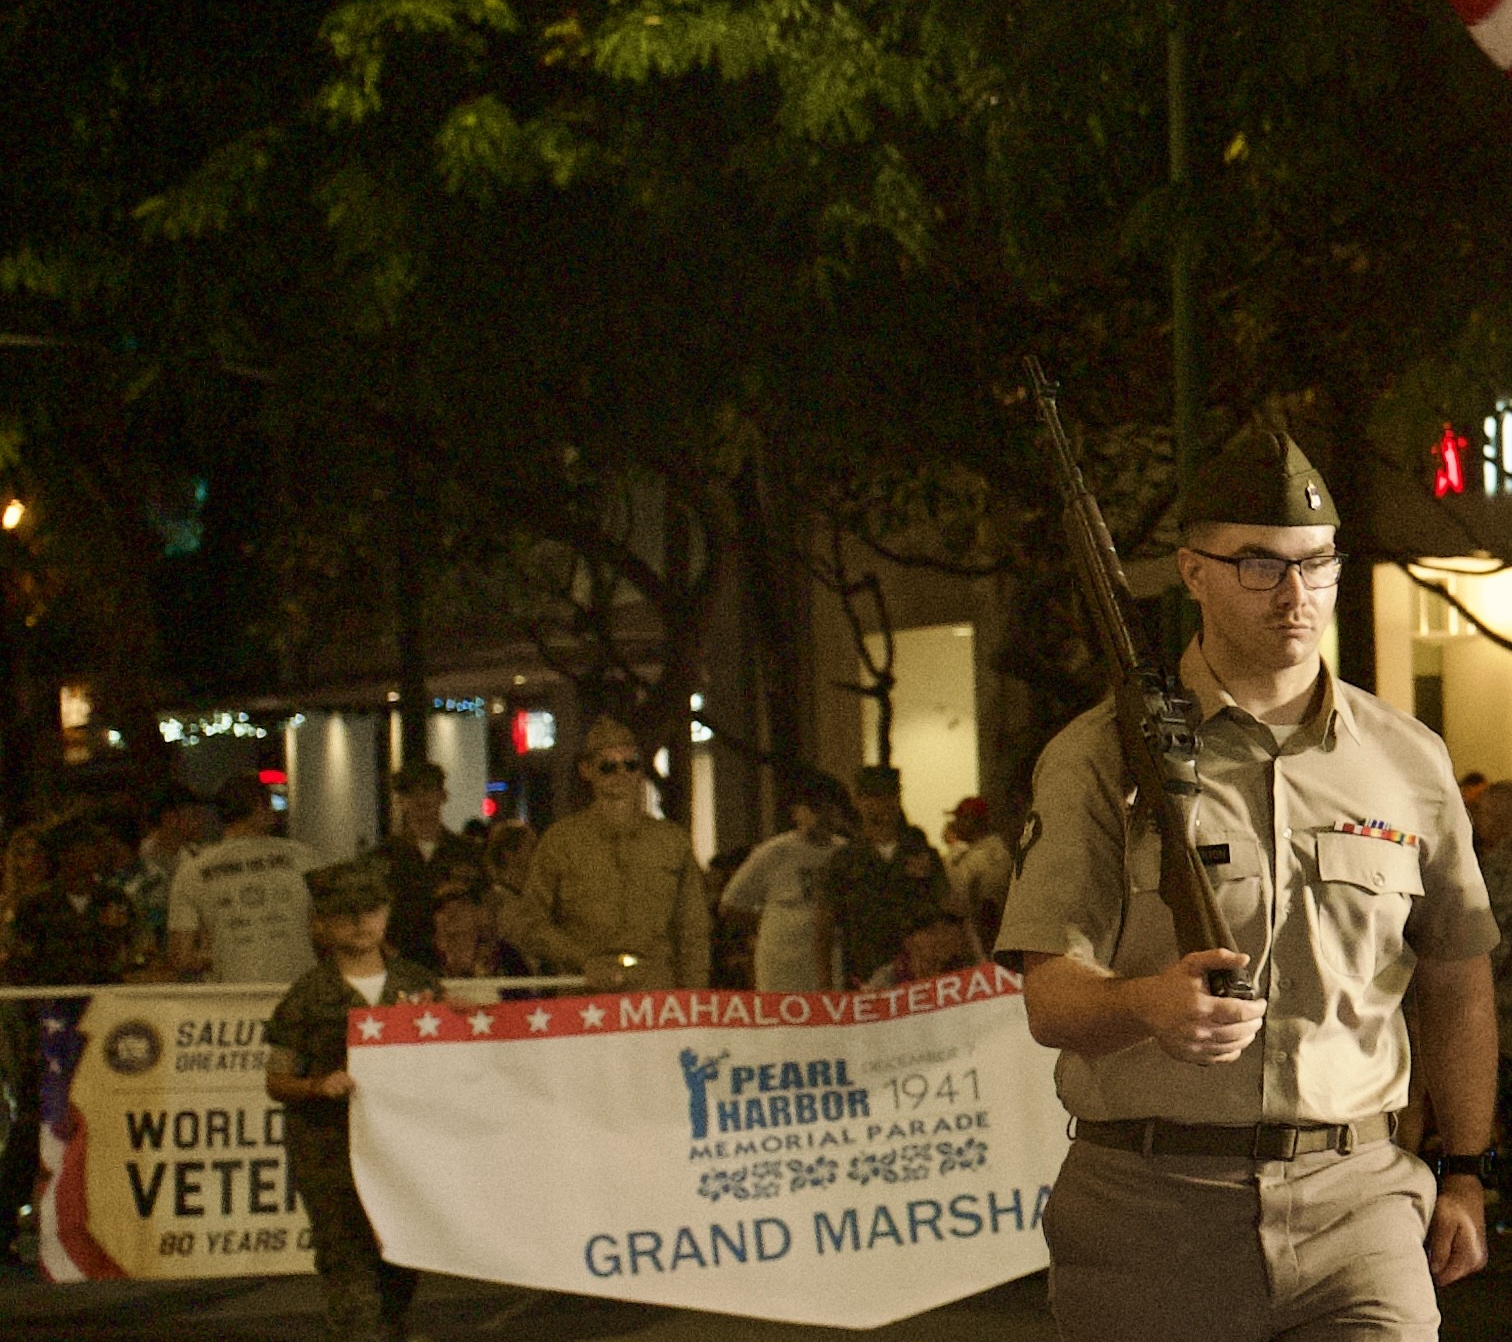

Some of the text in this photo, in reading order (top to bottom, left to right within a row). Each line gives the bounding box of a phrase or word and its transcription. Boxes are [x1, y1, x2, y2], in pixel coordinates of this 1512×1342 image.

[618, 994, 812, 1030] MAHALO
[730, 1058, 855, 1095] PEARL
[883, 1068, 982, 1112] 1941
[717, 1087, 871, 1133] HARBOR
[688, 1111, 991, 1161] MEMORIAL PARADE
[207, 1228, 288, 1256] YEARS
[583, 1216, 792, 1279] GRAND
